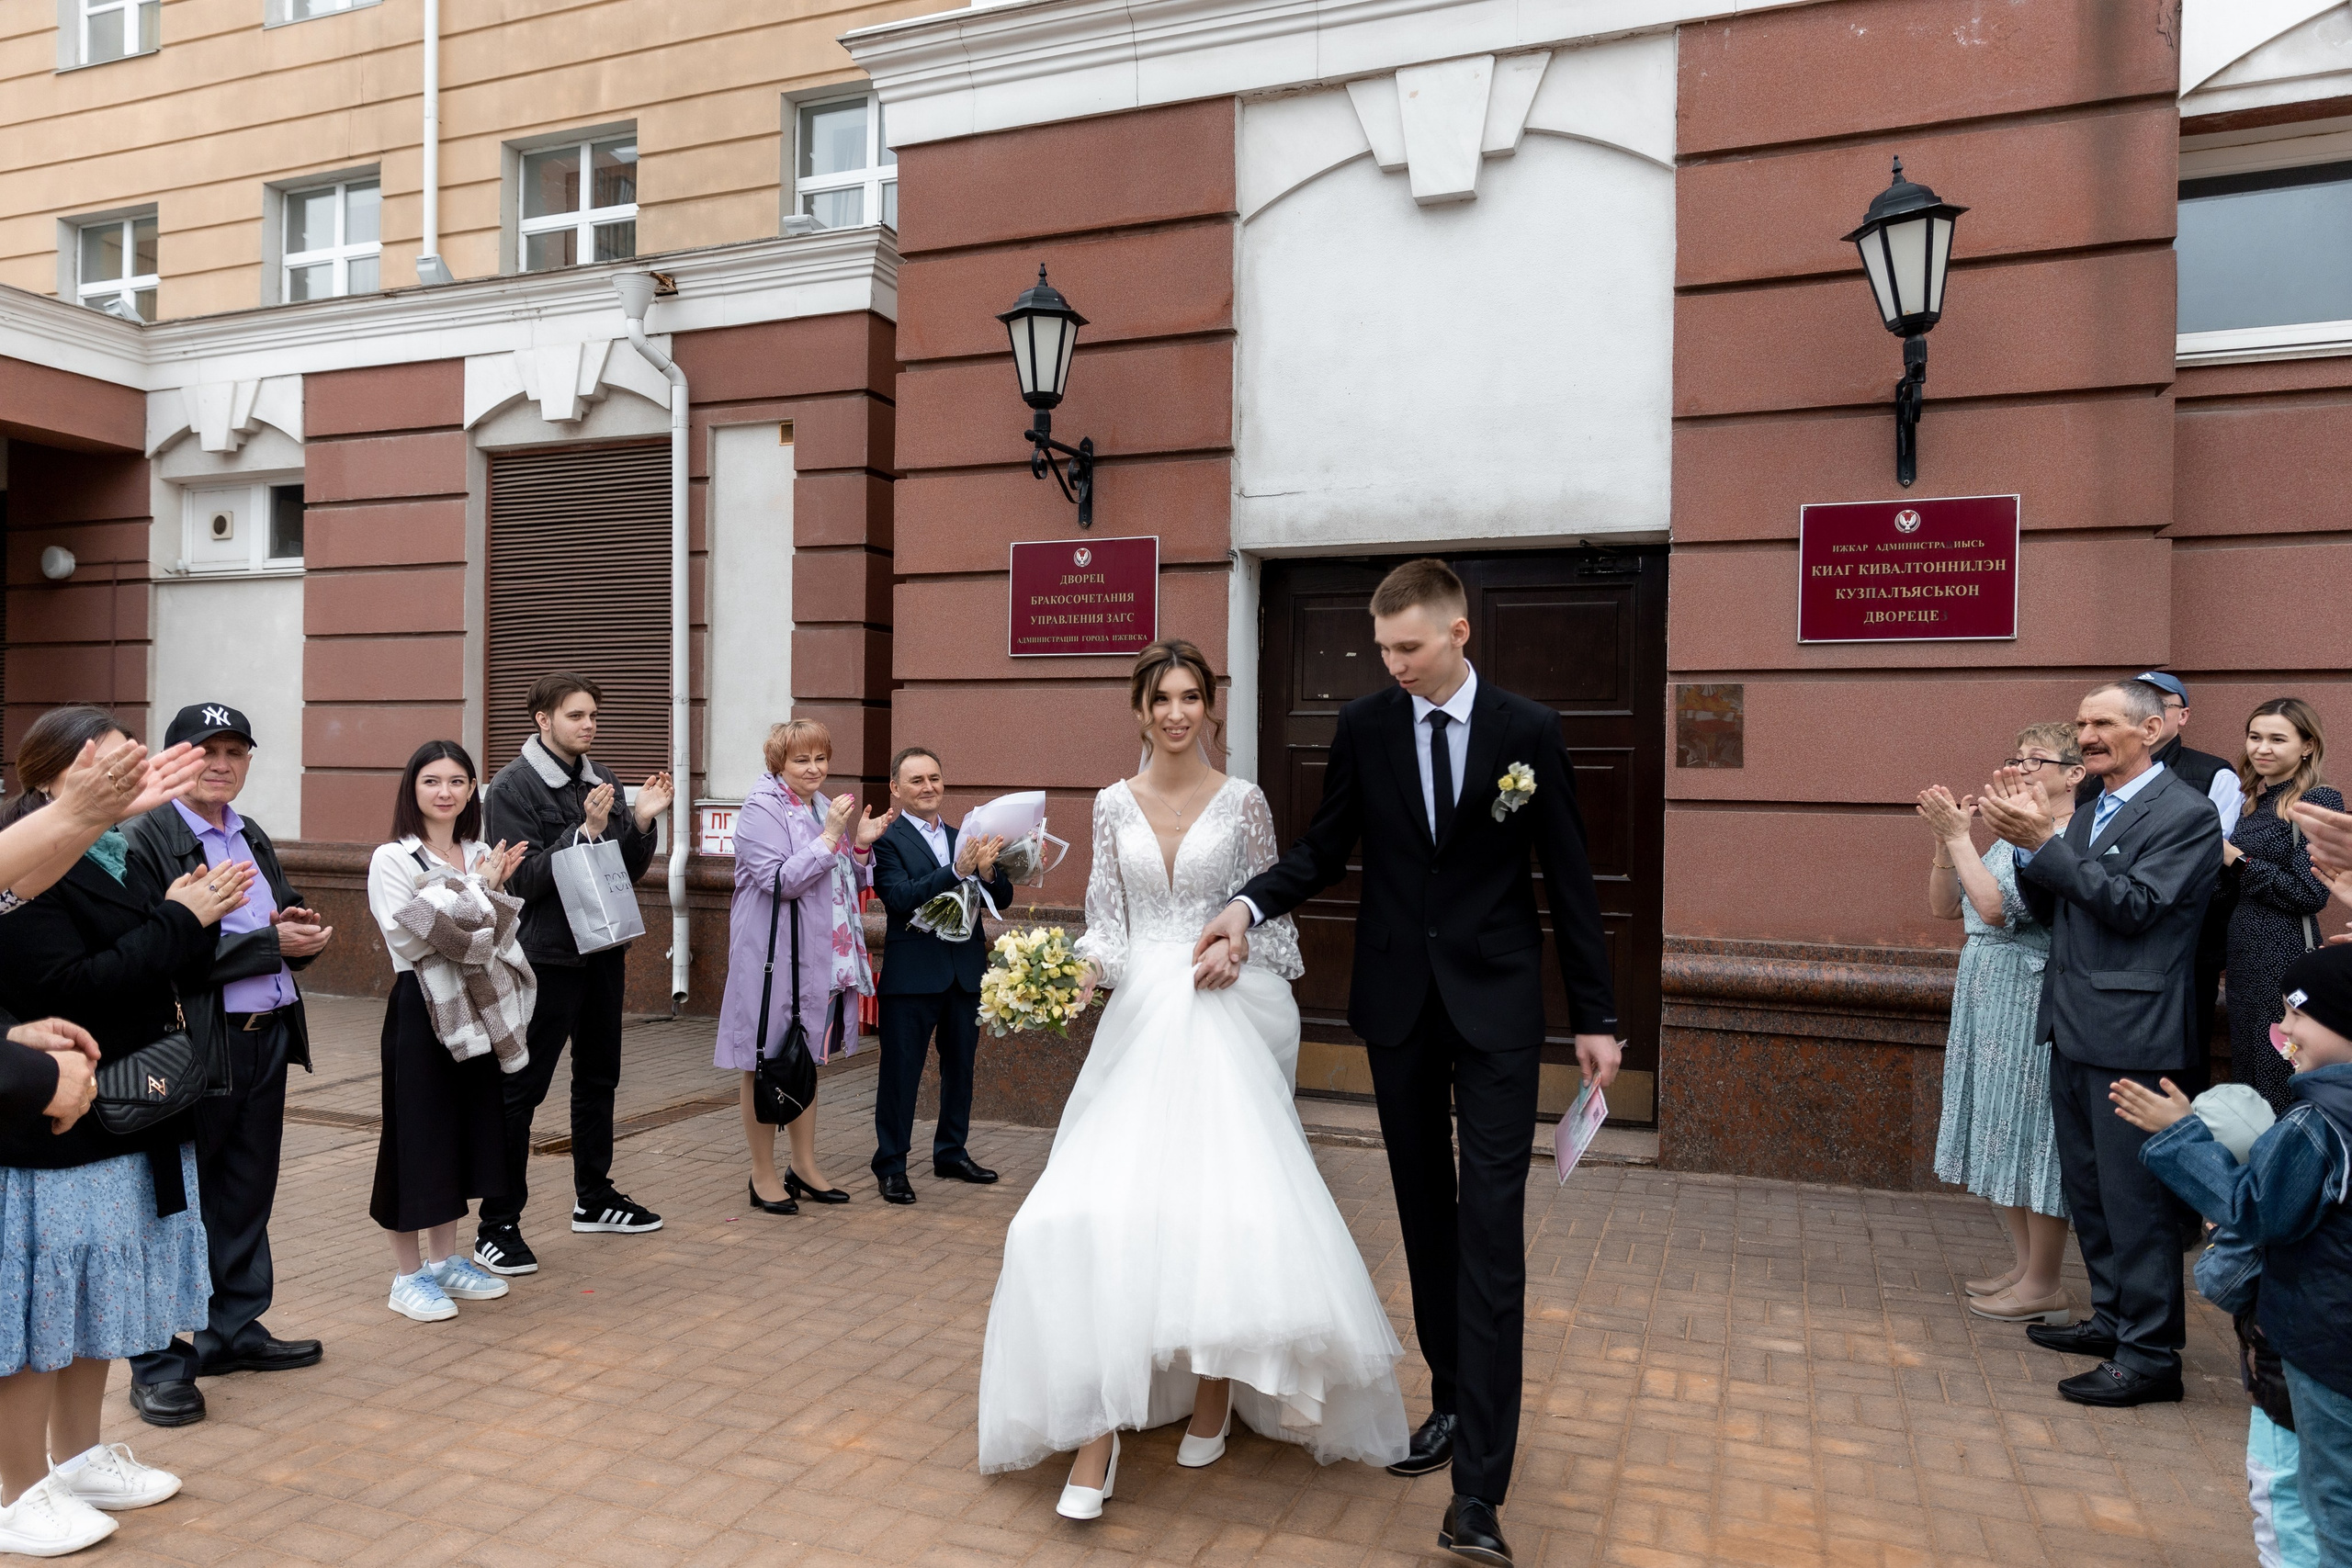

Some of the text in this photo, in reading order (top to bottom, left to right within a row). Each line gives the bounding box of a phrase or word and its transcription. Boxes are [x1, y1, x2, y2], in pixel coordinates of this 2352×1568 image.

[1832, 544, 1869, 553] ИЖКАР
[1811, 559, 2007, 577] КИАГ КИВАЛТОННИЛЭН
[1059, 573, 1105, 585] ДВОРЕЦ
[1835, 584, 1980, 600] КУЗПАЛЪЯСЬКОН
[1031, 592, 1135, 605] БРАКОСОЧЕТАНИЯ
[1030, 613, 1135, 625] УПРАВЛЕНИЯ ЗАГС
[1016, 636, 1079, 644] АДМИНИСТРАЦИИ
[711, 812, 732, 829] ПГ
